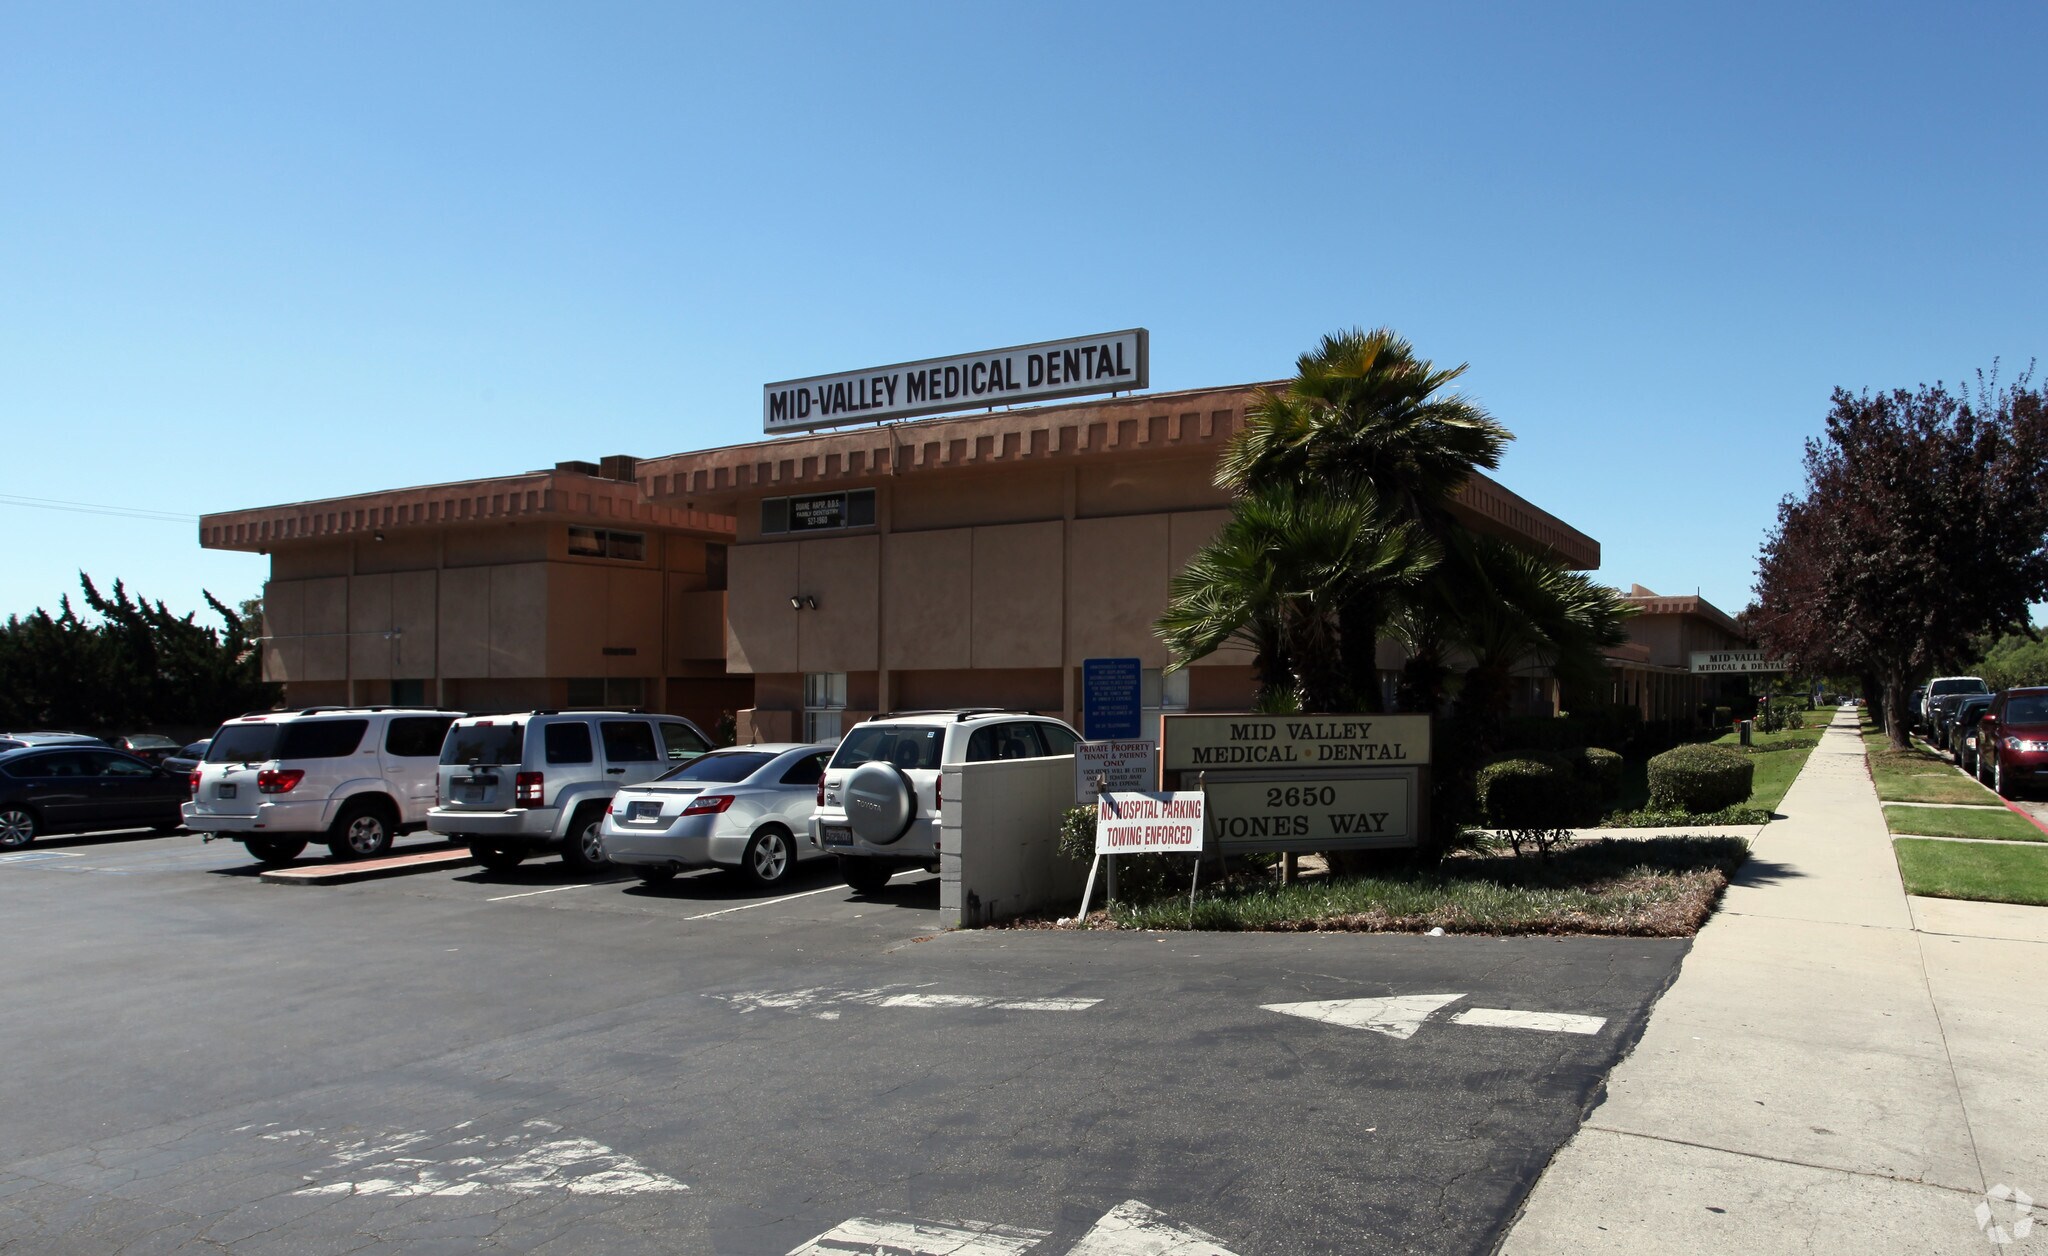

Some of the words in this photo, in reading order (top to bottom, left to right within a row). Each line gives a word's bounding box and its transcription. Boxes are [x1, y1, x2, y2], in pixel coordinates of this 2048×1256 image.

[770, 374, 899, 422] MID-VALLEY
[907, 358, 1021, 404] MEDICAL
[1027, 342, 1131, 388] DENTAL
[812, 508, 839, 516] DENTISTRY
[1698, 663, 1737, 671] MEDICAL
[1709, 654, 1766, 663] MID-VALLE
[1230, 723, 1276, 741] MID
[1286, 723, 1373, 740] VALLEY
[1080, 745, 1108, 753] PRIVATE
[1112, 743, 1150, 752] PROPERTY
[1119, 752, 1148, 760] PATIENTS
[1192, 745, 1298, 764] MEDICAL
[1318, 743, 1407, 761] DENTAL
[857, 799, 881, 812] TOYOTA
[1267, 786, 1336, 807] 2650
[1101, 801, 1113, 820] NO
[1116, 800, 1158, 819] HOSPITAL
[1162, 800, 1201, 819] PARKING
[1217, 815, 1309, 838] JONES
[1328, 813, 1389, 834] WAY
[1107, 826, 1142, 847] TOWING
[1145, 825, 1192, 845] ENFORCED
